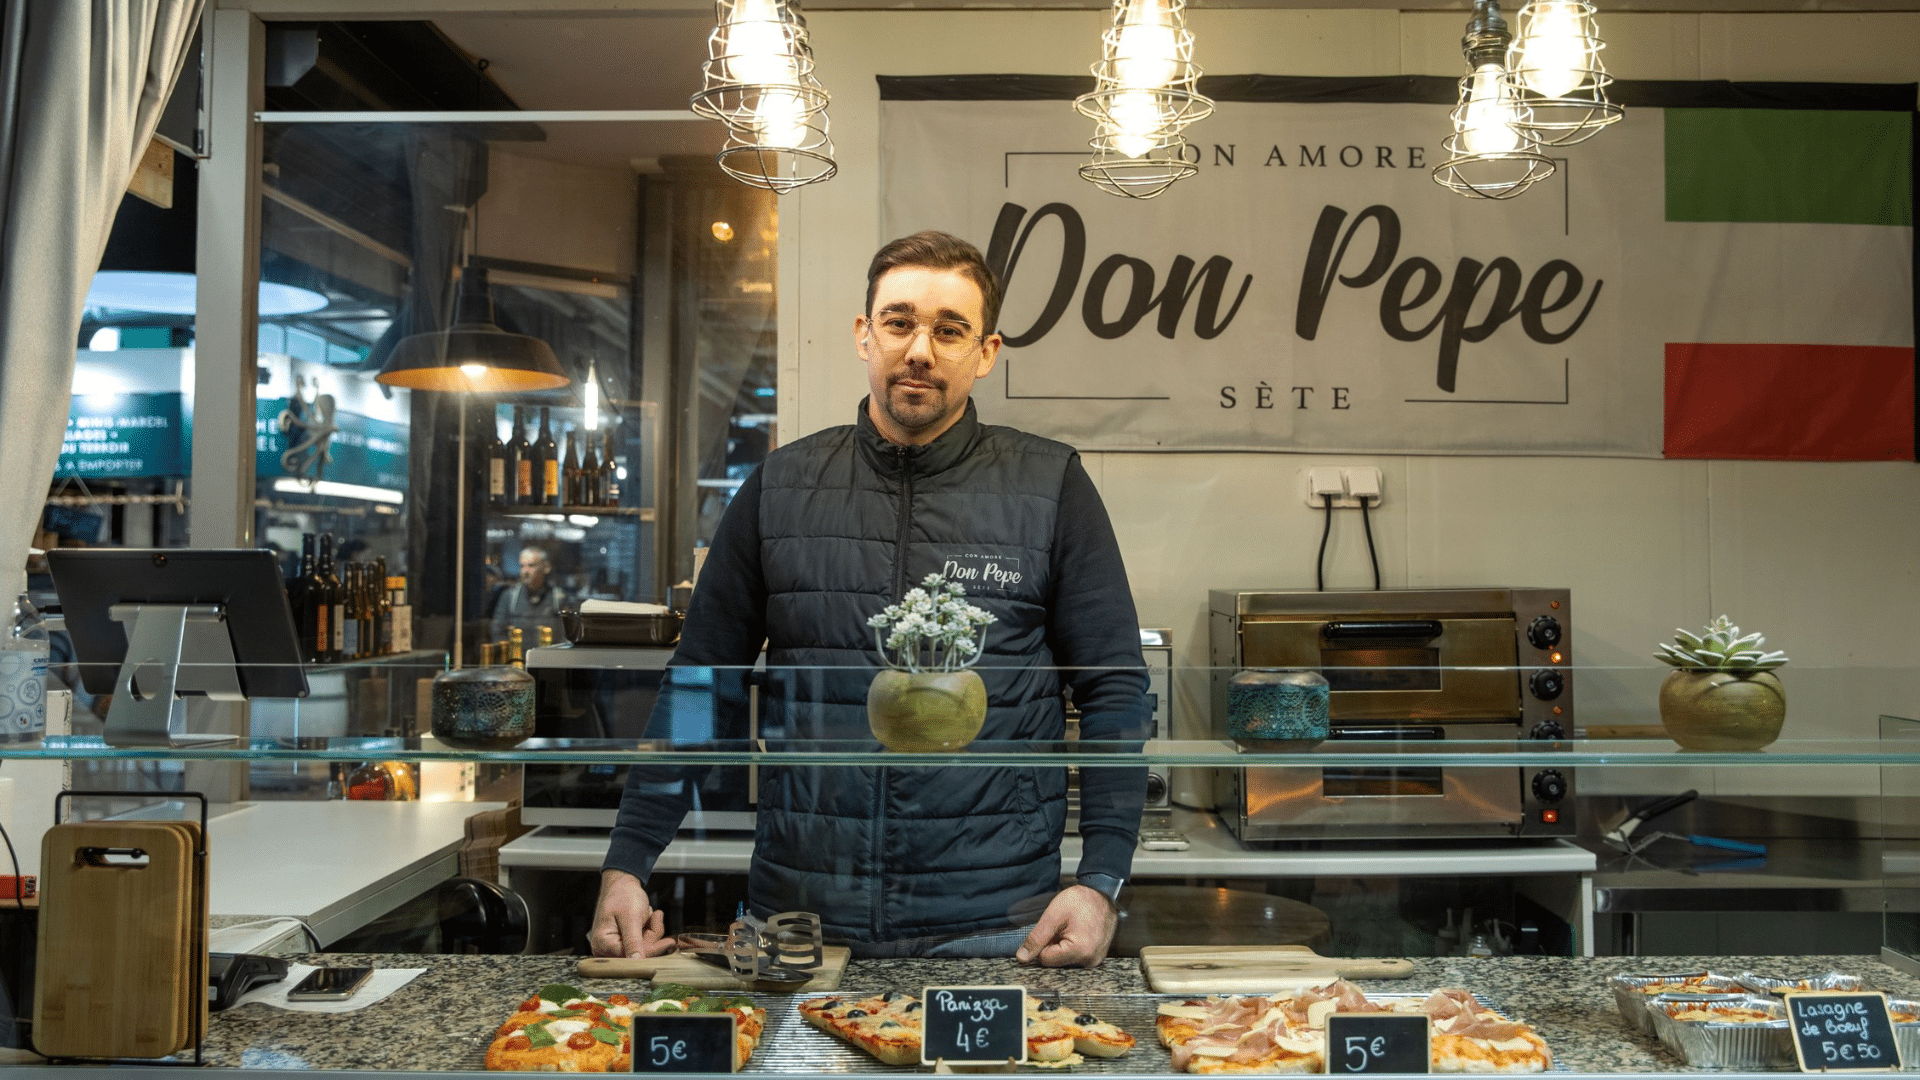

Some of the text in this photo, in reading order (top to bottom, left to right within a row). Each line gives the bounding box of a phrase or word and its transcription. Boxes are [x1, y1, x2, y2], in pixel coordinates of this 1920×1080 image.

[1263, 144, 1427, 169] AMORE
[984, 201, 1604, 393] Don Pepe
[1218, 380, 1352, 411] SÈTE
[943, 560, 1023, 589] Don Pepe
[935, 990, 1009, 1022] Panizza
[1797, 1000, 1869, 1021] Lasagne
[1801, 1020, 1820, 1036] de
[650, 1035, 688, 1066] 5€
[1344, 1036, 1386, 1072] 5€
